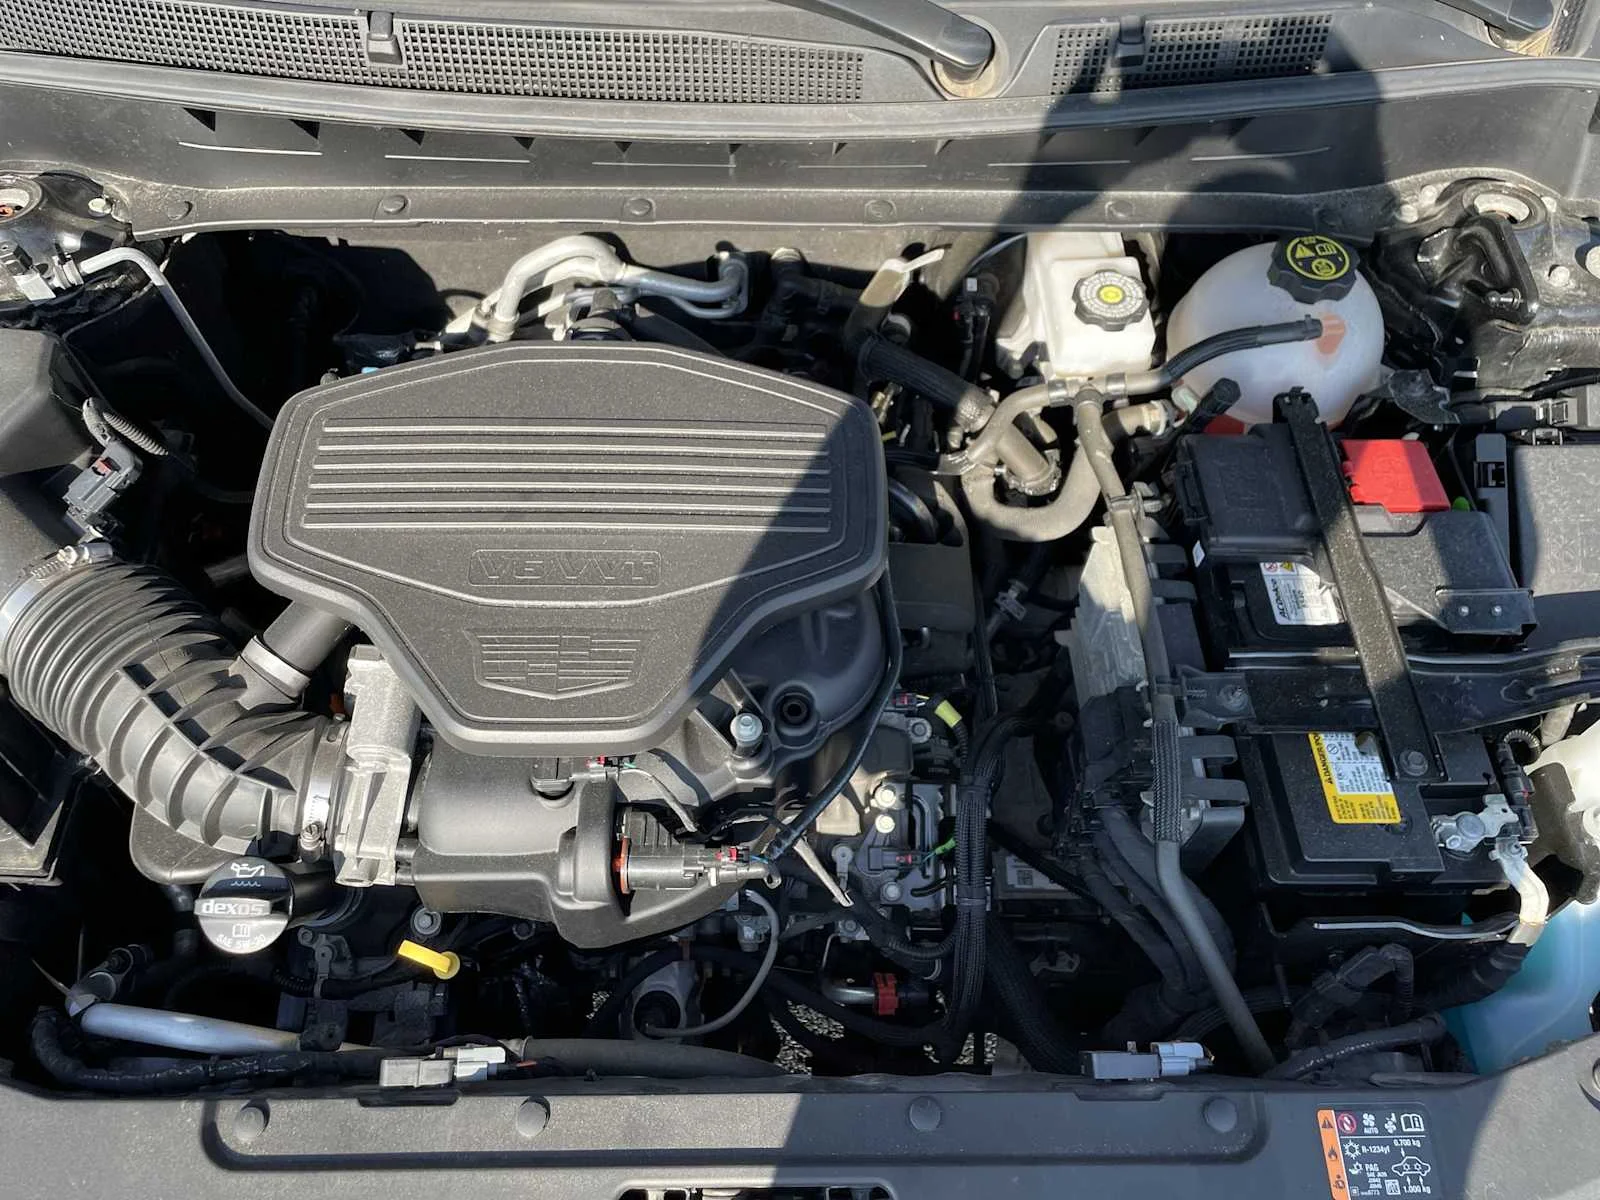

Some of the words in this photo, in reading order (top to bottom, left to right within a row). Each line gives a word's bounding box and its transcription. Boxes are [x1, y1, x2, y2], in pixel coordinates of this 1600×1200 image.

[201, 899, 265, 915] dexos
[216, 933, 233, 948] SAE
[1361, 1146, 1390, 1154] R-1234yf
[1365, 1163, 1379, 1172] PAG
